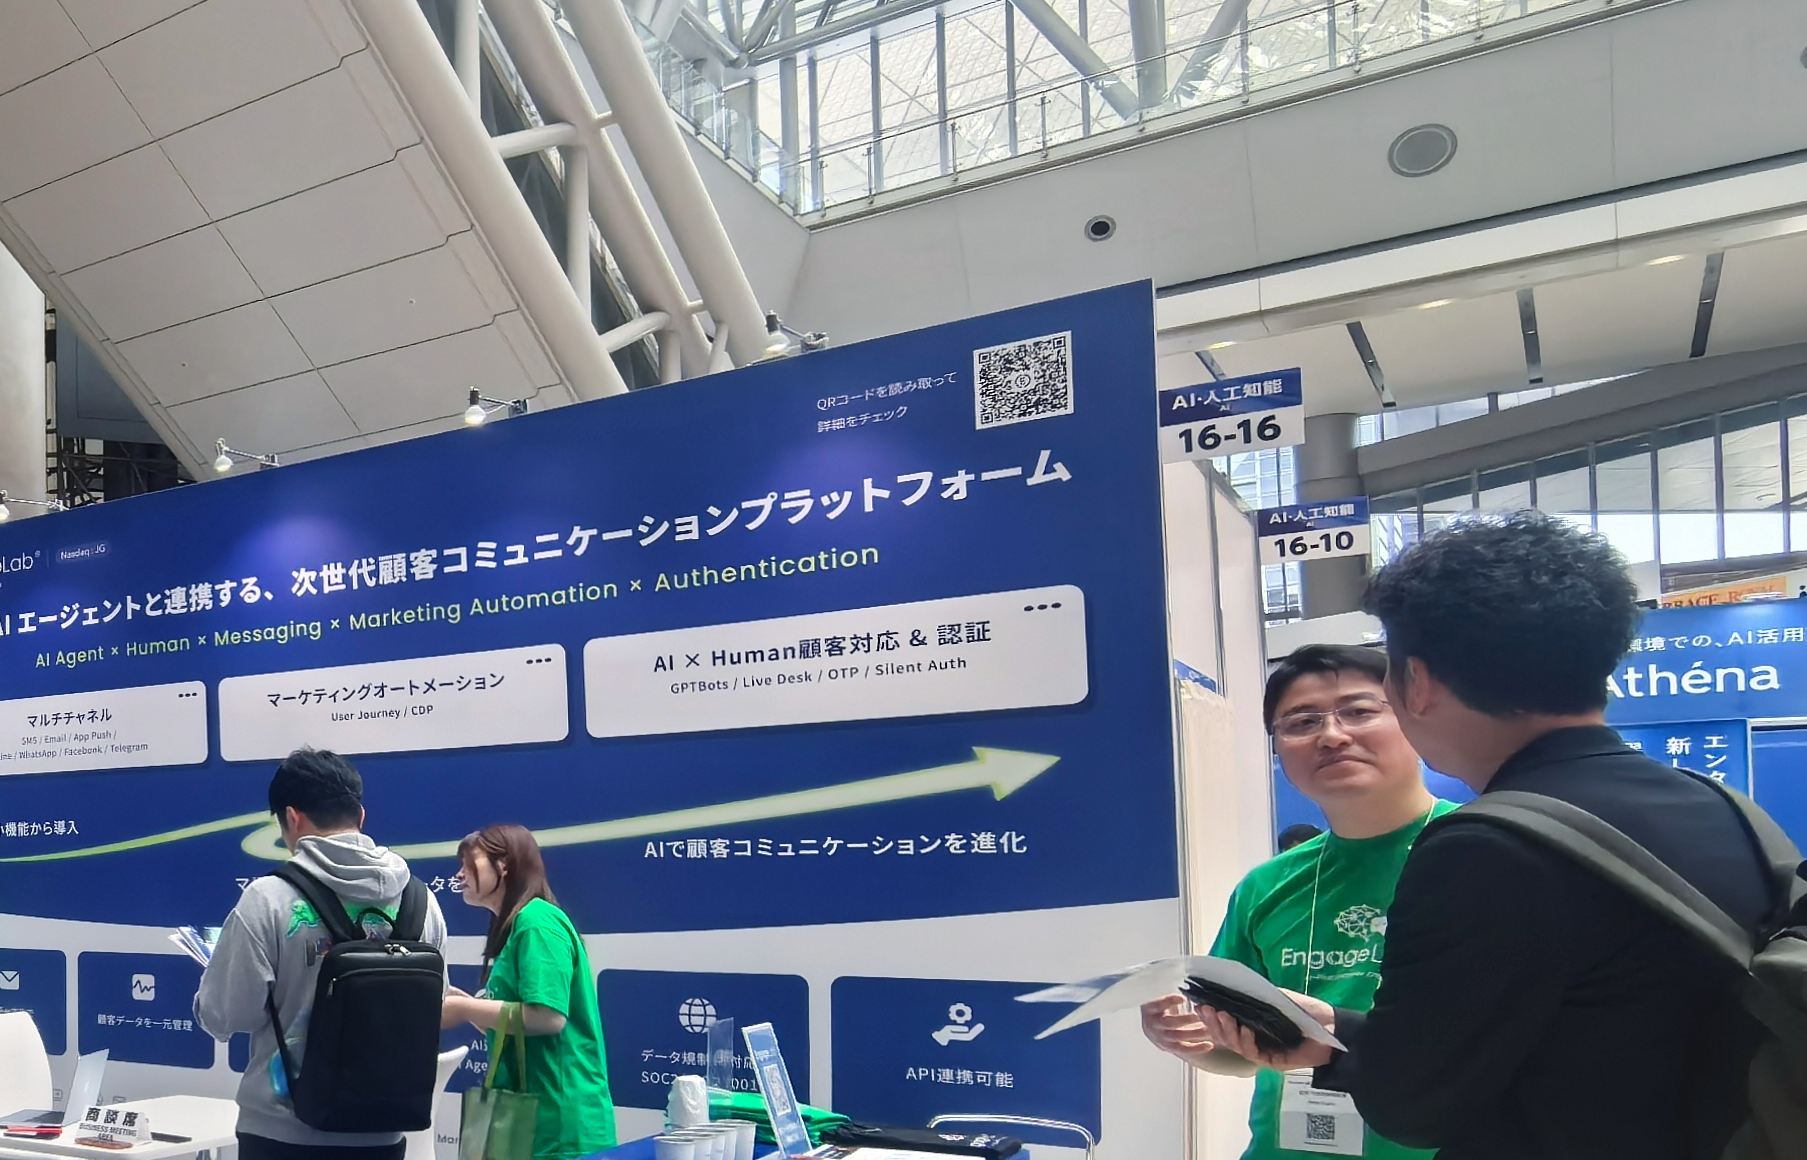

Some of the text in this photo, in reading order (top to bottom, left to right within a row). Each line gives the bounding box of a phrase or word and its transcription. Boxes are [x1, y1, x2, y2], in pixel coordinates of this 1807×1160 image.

[1178, 414, 1281, 453] 16-16
[1274, 531, 1354, 557] 16-10
[36, 651, 50, 668] AI
[56, 647, 104, 669] Agent
[127, 635, 190, 657] Human
[214, 620, 322, 646] Messaging
[350, 601, 461, 631] Marketing
[470, 581, 618, 616] Automation
[655, 546, 879, 592] Authentication
[937, 620, 992, 647] 認証
[670, 679, 728, 695] GPTBots
[743, 675, 772, 688] Live
[777, 671, 812, 686] Desk
[828, 667, 859, 681] OTP
[875, 661, 922, 676] Silent
[927, 657, 967, 672] Auth
[267, 672, 505, 707] マーケティングオートメーション
[27, 708, 112, 728] マルチチャネル
[331, 711, 354, 722] User
[357, 706, 400, 720] Journey
[411, 704, 433, 717] CDP
[22, 736, 38, 746] SMS
[44, 733, 67, 745] Email
[74, 731, 89, 743] App
[92, 730, 112, 741] Push
[19, 748, 57, 761] WhatsApp
[64, 745, 103, 757] Facebook
[110, 742, 148, 754] Telegram
[644, 830, 1028, 860] AIで顧客コミュニケーションを進化
[1281, 947, 1382, 969] EngageL
[97, 1014, 193, 1031] 顧客データを一元管理
[906, 1067, 1014, 1089] API連携可能
